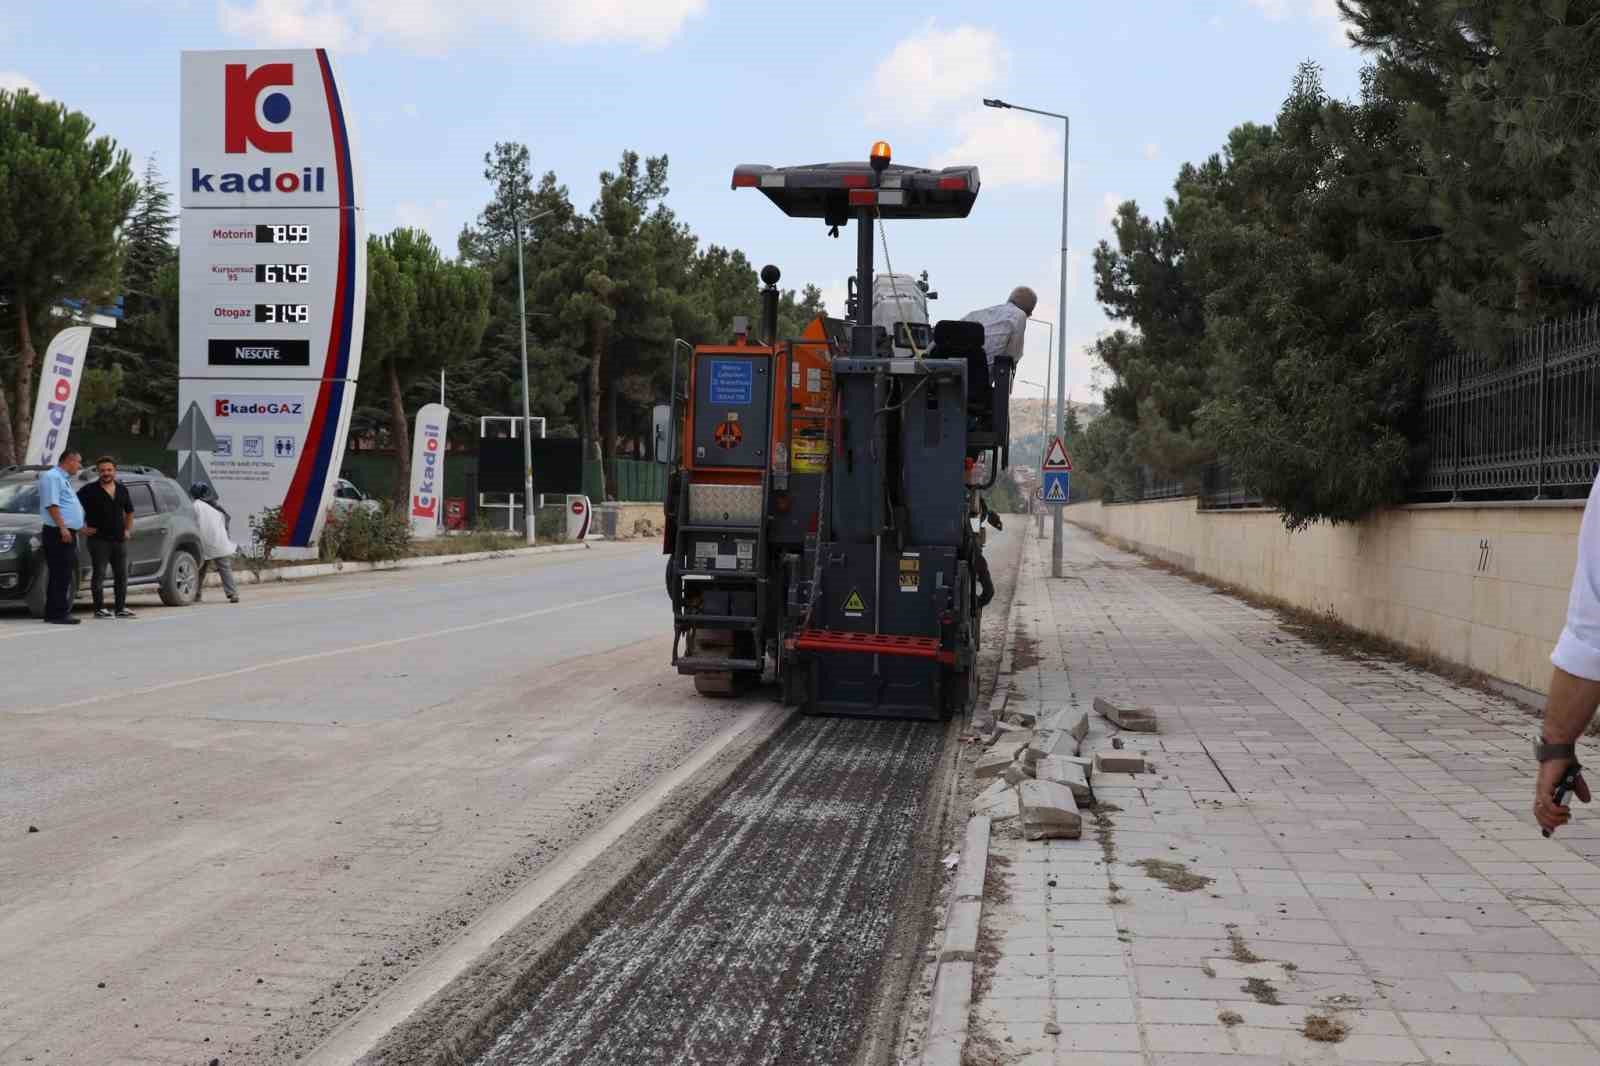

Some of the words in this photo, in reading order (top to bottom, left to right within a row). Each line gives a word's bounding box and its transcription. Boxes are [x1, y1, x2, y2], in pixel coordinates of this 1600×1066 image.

[192, 167, 325, 193] kadoil
[212, 229, 254, 239] Motorin
[214, 307, 252, 319] Otogaz
[230, 403, 302, 414] kadoGAZ
[419, 424, 440, 494] kadoil
